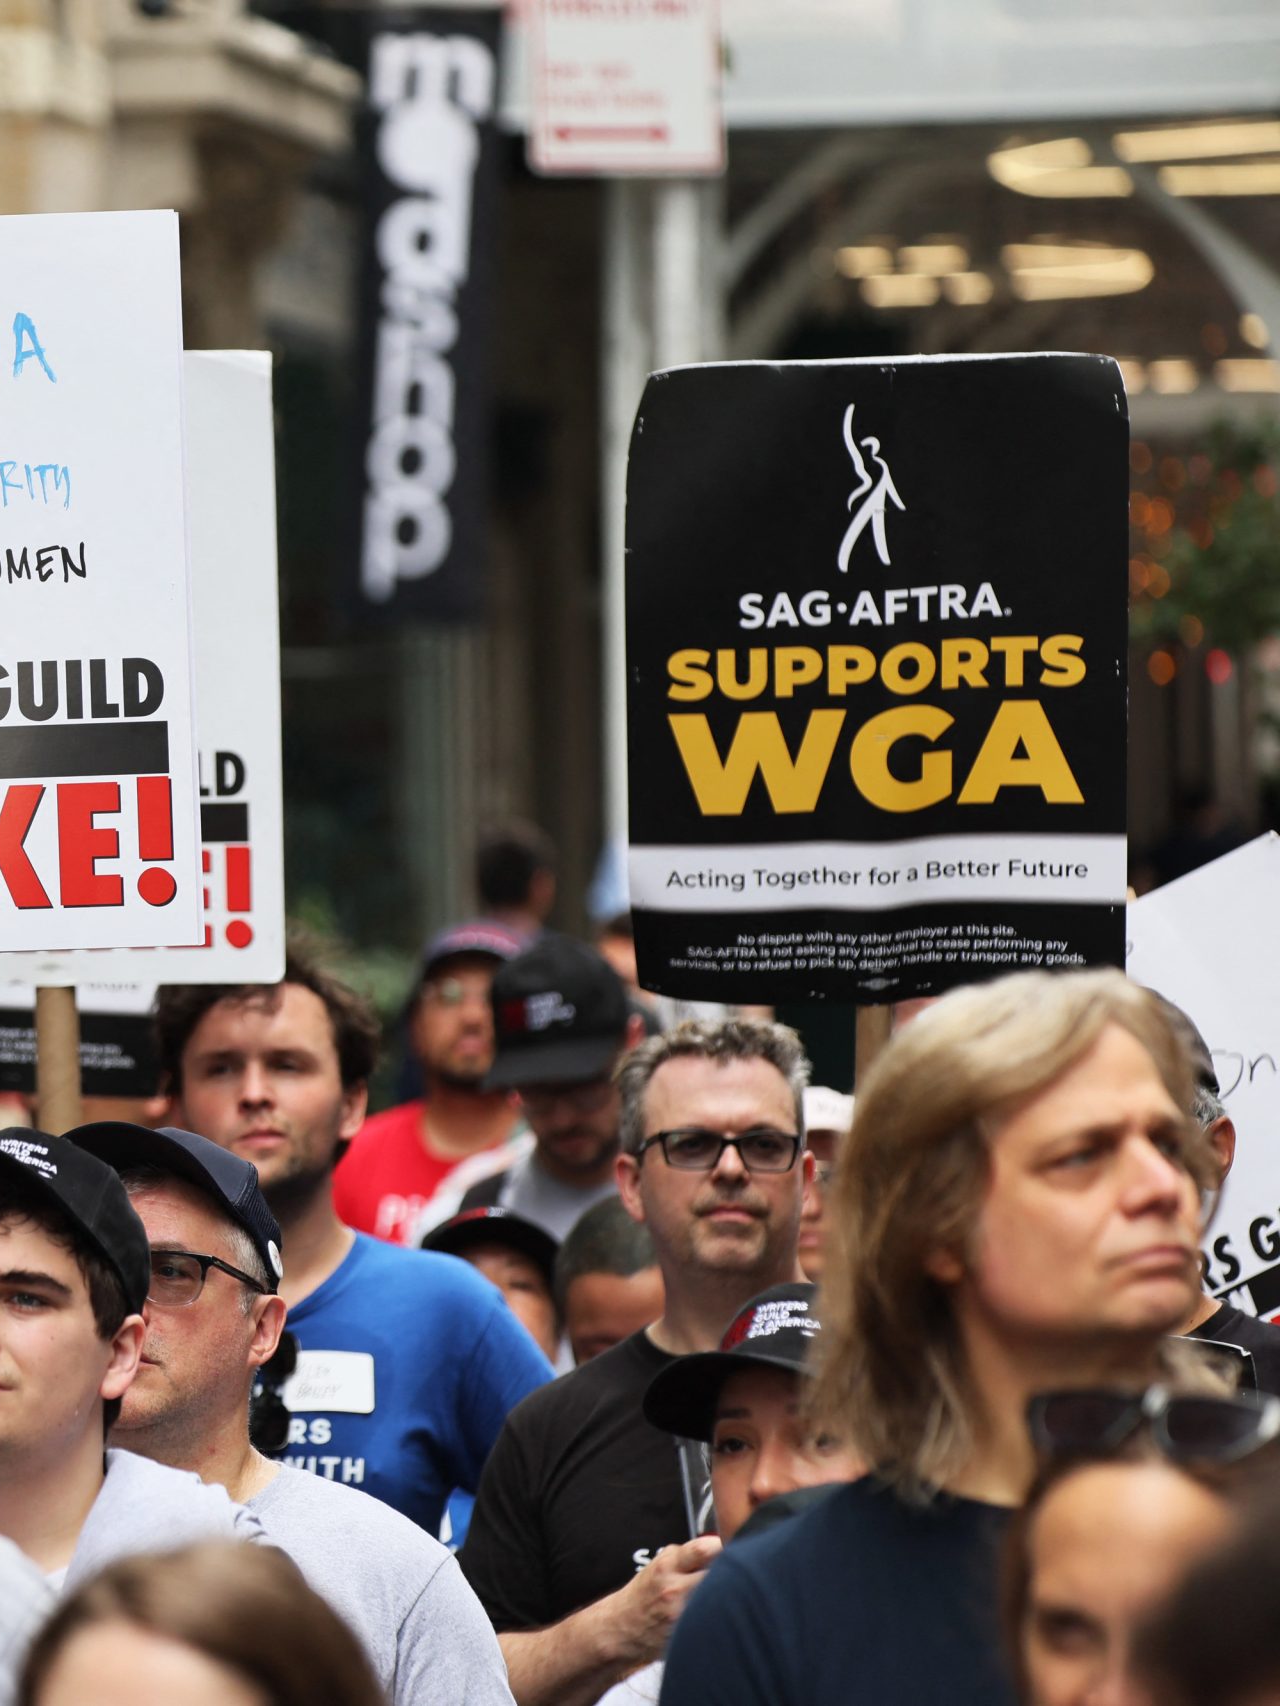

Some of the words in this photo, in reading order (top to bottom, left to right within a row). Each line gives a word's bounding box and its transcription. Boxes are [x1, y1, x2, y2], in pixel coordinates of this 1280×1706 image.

[666, 633, 1087, 702] SUPPORTS
[667, 699, 1086, 817] WGA
[666, 869, 745, 892] Acting
[753, 866, 859, 890] Together
[868, 866, 902, 887] for
[907, 869, 919, 883] a
[926, 859, 1000, 880] Better
[1008, 858, 1089, 879] Future
[737, 934, 755, 945] No
[758, 932, 803, 946] dispute
[806, 931, 833, 943] with
[836, 933, 858, 946] any
[861, 931, 893, 945] other
[895, 925, 948, 942] employer
[951, 925, 963, 936] at
[967, 924, 990, 936] this
[760, 946, 771, 958] is
[773, 947, 794, 958] not
[795, 945, 836, 958] asking
[838, 946, 860, 959] any
[864, 940, 919, 957] individual
[921, 939, 934, 949] to
[936, 938, 970, 949] cease
[973, 938, 1043, 952] performing
[1045, 939, 1069, 952] any
[723, 961, 736, 971] or
[738, 960, 752, 971] to
[753, 959, 792, 971] refuse
[794, 957, 807, 969] to
[809, 957, 835, 969] pick
[903, 950, 943, 964] handle
[945, 952, 959, 962] or
[961, 950, 1018, 964] transport
[1021, 952, 1043, 965] any
[0, 1138, 49, 1156] WRITERS
[756, 1300, 809, 1313] WRITERS
